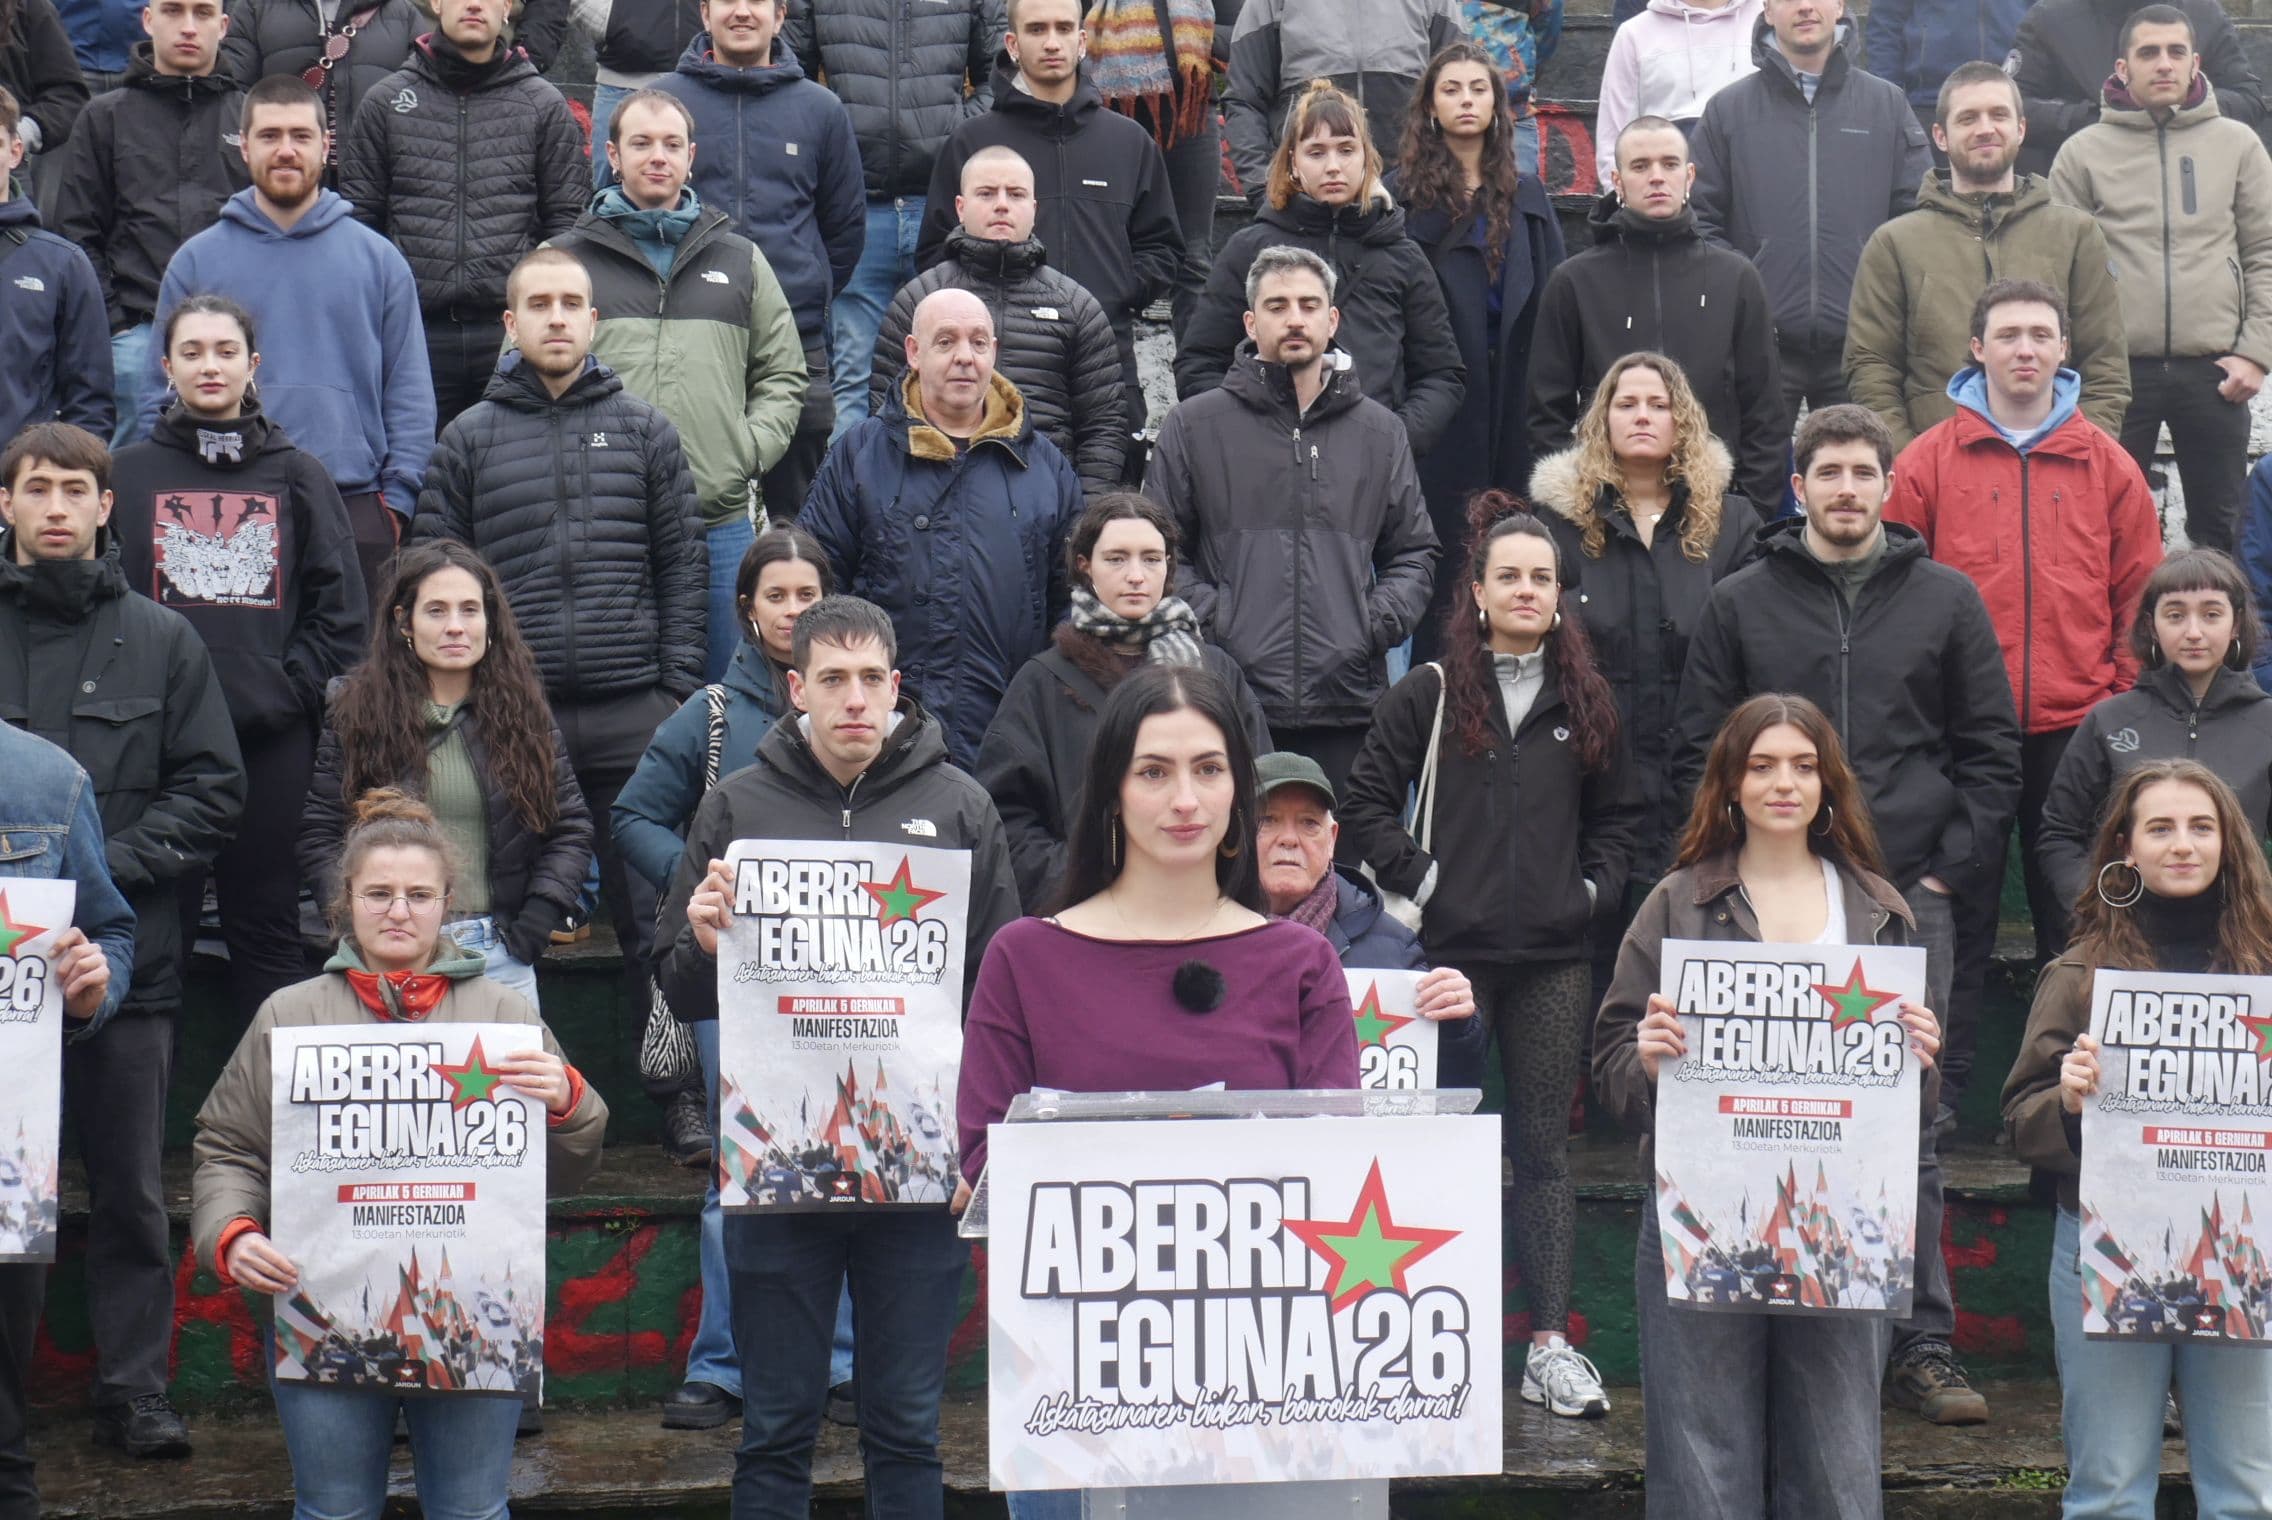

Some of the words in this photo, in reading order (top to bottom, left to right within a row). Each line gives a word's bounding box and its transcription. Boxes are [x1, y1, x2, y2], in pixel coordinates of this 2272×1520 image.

[733, 858, 873, 917] ABERRI
[759, 916, 887, 972] EGUNA
[891, 918, 948, 973] 26
[1677, 959, 1825, 1019] ABERRI
[792, 999, 838, 1013] APIRILAK
[840, 999, 848, 1013] 5
[850, 999, 896, 1013] GERNIKAN
[793, 1018, 899, 1039] MANIFESTAZIOA
[2102, 990, 2251, 1050] ABERRI
[792, 1041, 840, 1051] 13:00etan
[843, 1042, 901, 1051] Merkuriotik
[1701, 1016, 1838, 1075] EGUNA
[1843, 1020, 1904, 1075] 26
[291, 1042, 443, 1103] ABERRI
[1360, 1043, 1418, 1090] 26
[2125, 1048, 2261, 1106] EGUNA
[1733, 1098, 1779, 1113] APIRILAK
[1781, 1099, 1789, 1114] 5
[1791, 1100, 1841, 1115] GERNIKAN
[2227, 1096, 2272, 1117] borroka
[317, 1100, 457, 1157] EGUNA
[465, 1098, 527, 1155] 26
[1733, 1118, 1842, 1141] MANIFESTAZIOA
[2157, 1129, 2203, 1144] APIRILAK
[2204, 1131, 2213, 1145] 5
[2214, 1131, 2265, 1147] GERNIKAN
[1732, 1141, 1780, 1152] 13:00etan
[1783, 1143, 1843, 1154] Merkuriotik
[2157, 1148, 2266, 1173] MANIFESTAZIOA
[2156, 1171, 2205, 1182] 13:00etan
[2208, 1174, 2267, 1185] Merkuriotik
[352, 1185, 399, 1200] APIRILAK
[402, 1185, 410, 1200] 5
[412, 1184, 464, 1199] GERNIKAN
[353, 1205, 465, 1226] MANIFESTAZIOA
[352, 1229, 401, 1239] 13:00etan
[405, 1228, 466, 1238] Merkuriotik
[1020, 1176, 1311, 1299] ABERRI
[1073, 1290, 1342, 1408] EGUNA
[1353, 1285, 1470, 1402] 26
[1024, 1391, 1186, 1436] Askatasunaren
[1190, 1385, 1272, 1429] bidean,
[1279, 1382, 1381, 1425] borrokak
[1384, 1382, 1472, 1424] darrai!
